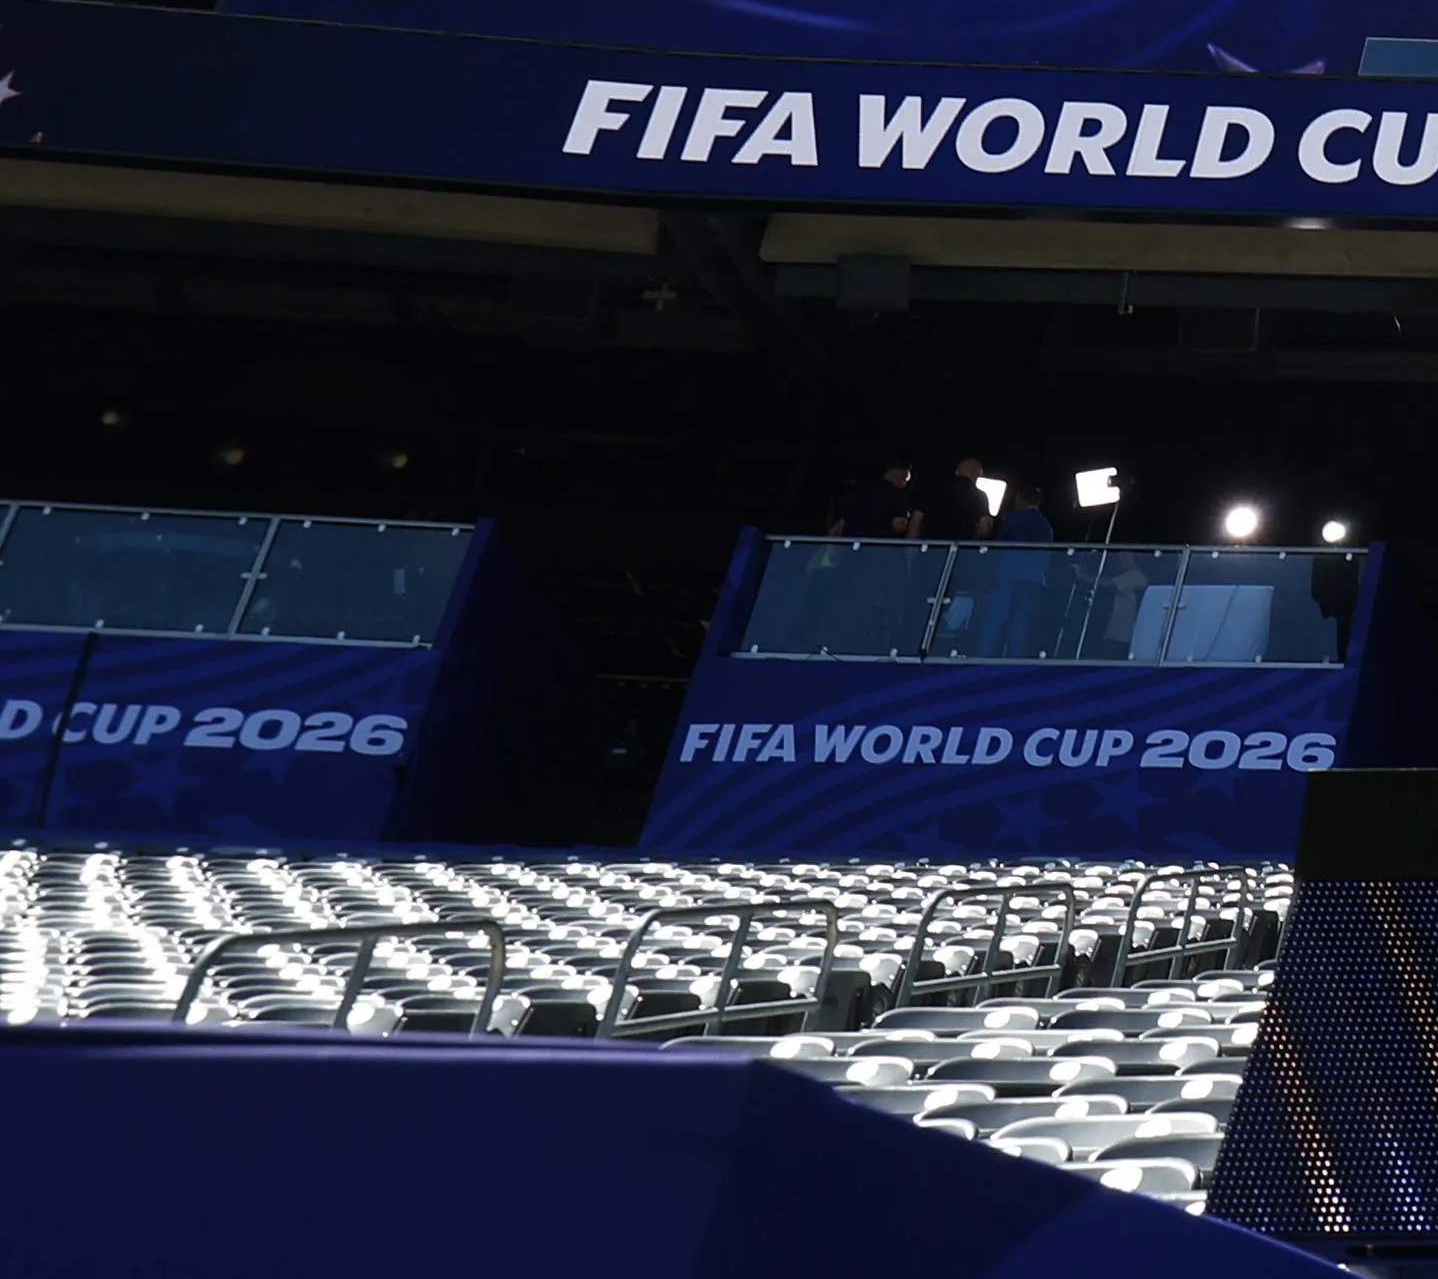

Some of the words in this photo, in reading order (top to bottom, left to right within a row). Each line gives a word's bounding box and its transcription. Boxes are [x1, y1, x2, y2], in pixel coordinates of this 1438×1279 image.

[562, 79, 819, 167] FIFA
[857, 93, 1276, 180] WORLD
[52, 701, 182, 746] CUP
[183, 707, 408, 756] 2026
[678, 723, 797, 763] FIFA
[813, 723, 1015, 766] WORLD
[1022, 727, 1134, 768] CUP
[1138, 729, 1338, 773] 2026
